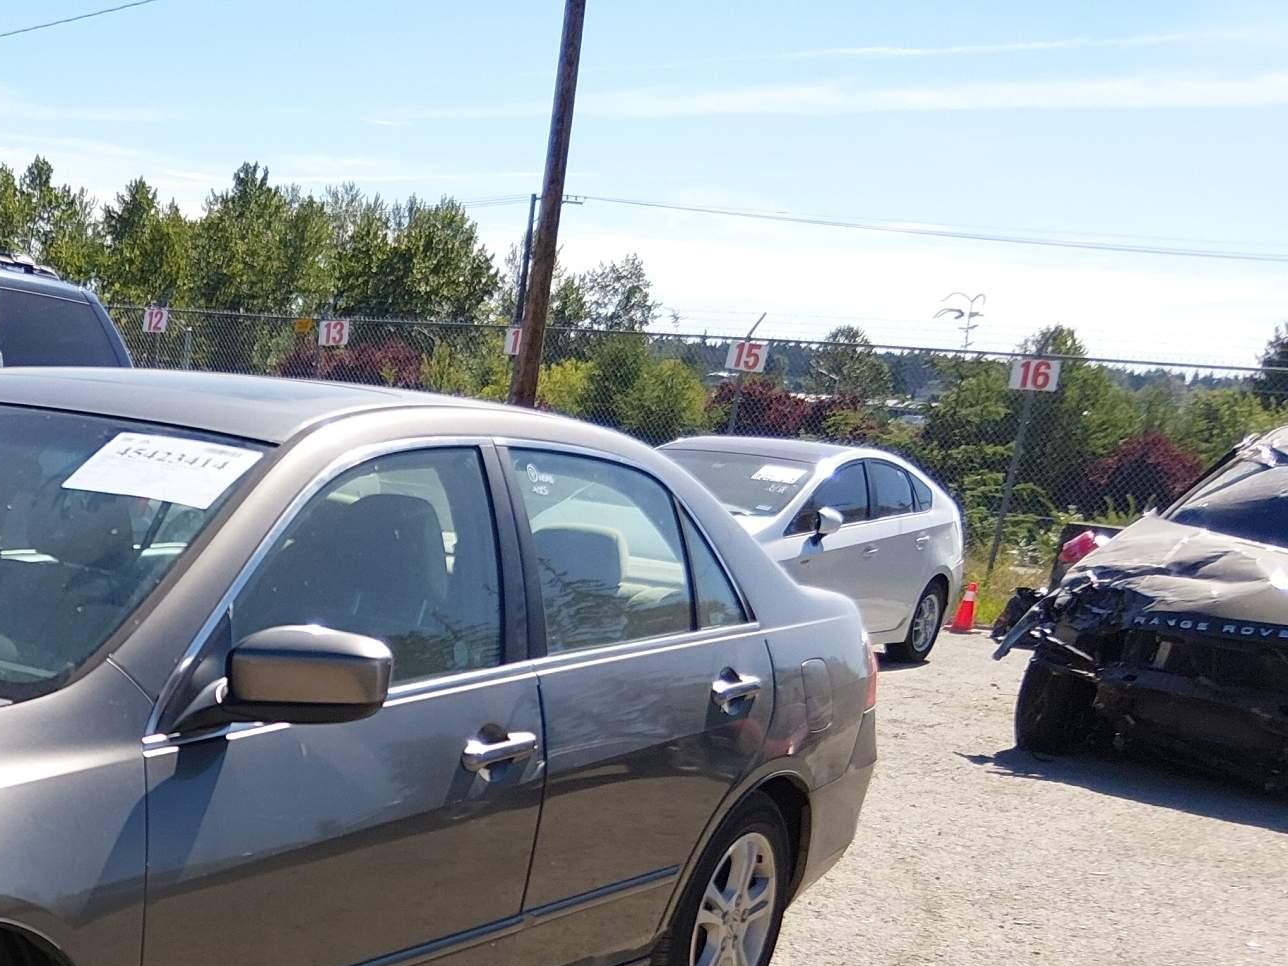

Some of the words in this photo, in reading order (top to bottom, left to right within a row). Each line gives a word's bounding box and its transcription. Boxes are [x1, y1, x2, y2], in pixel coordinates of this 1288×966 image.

[148, 311, 163, 330] 12
[324, 322, 345, 344] 13
[512, 330, 520, 353] 1
[734, 342, 761, 370] 15
[1020, 360, 1051, 389] 16
[116, 447, 229, 470] 45423414
[1134, 616, 1208, 630] RANGE
